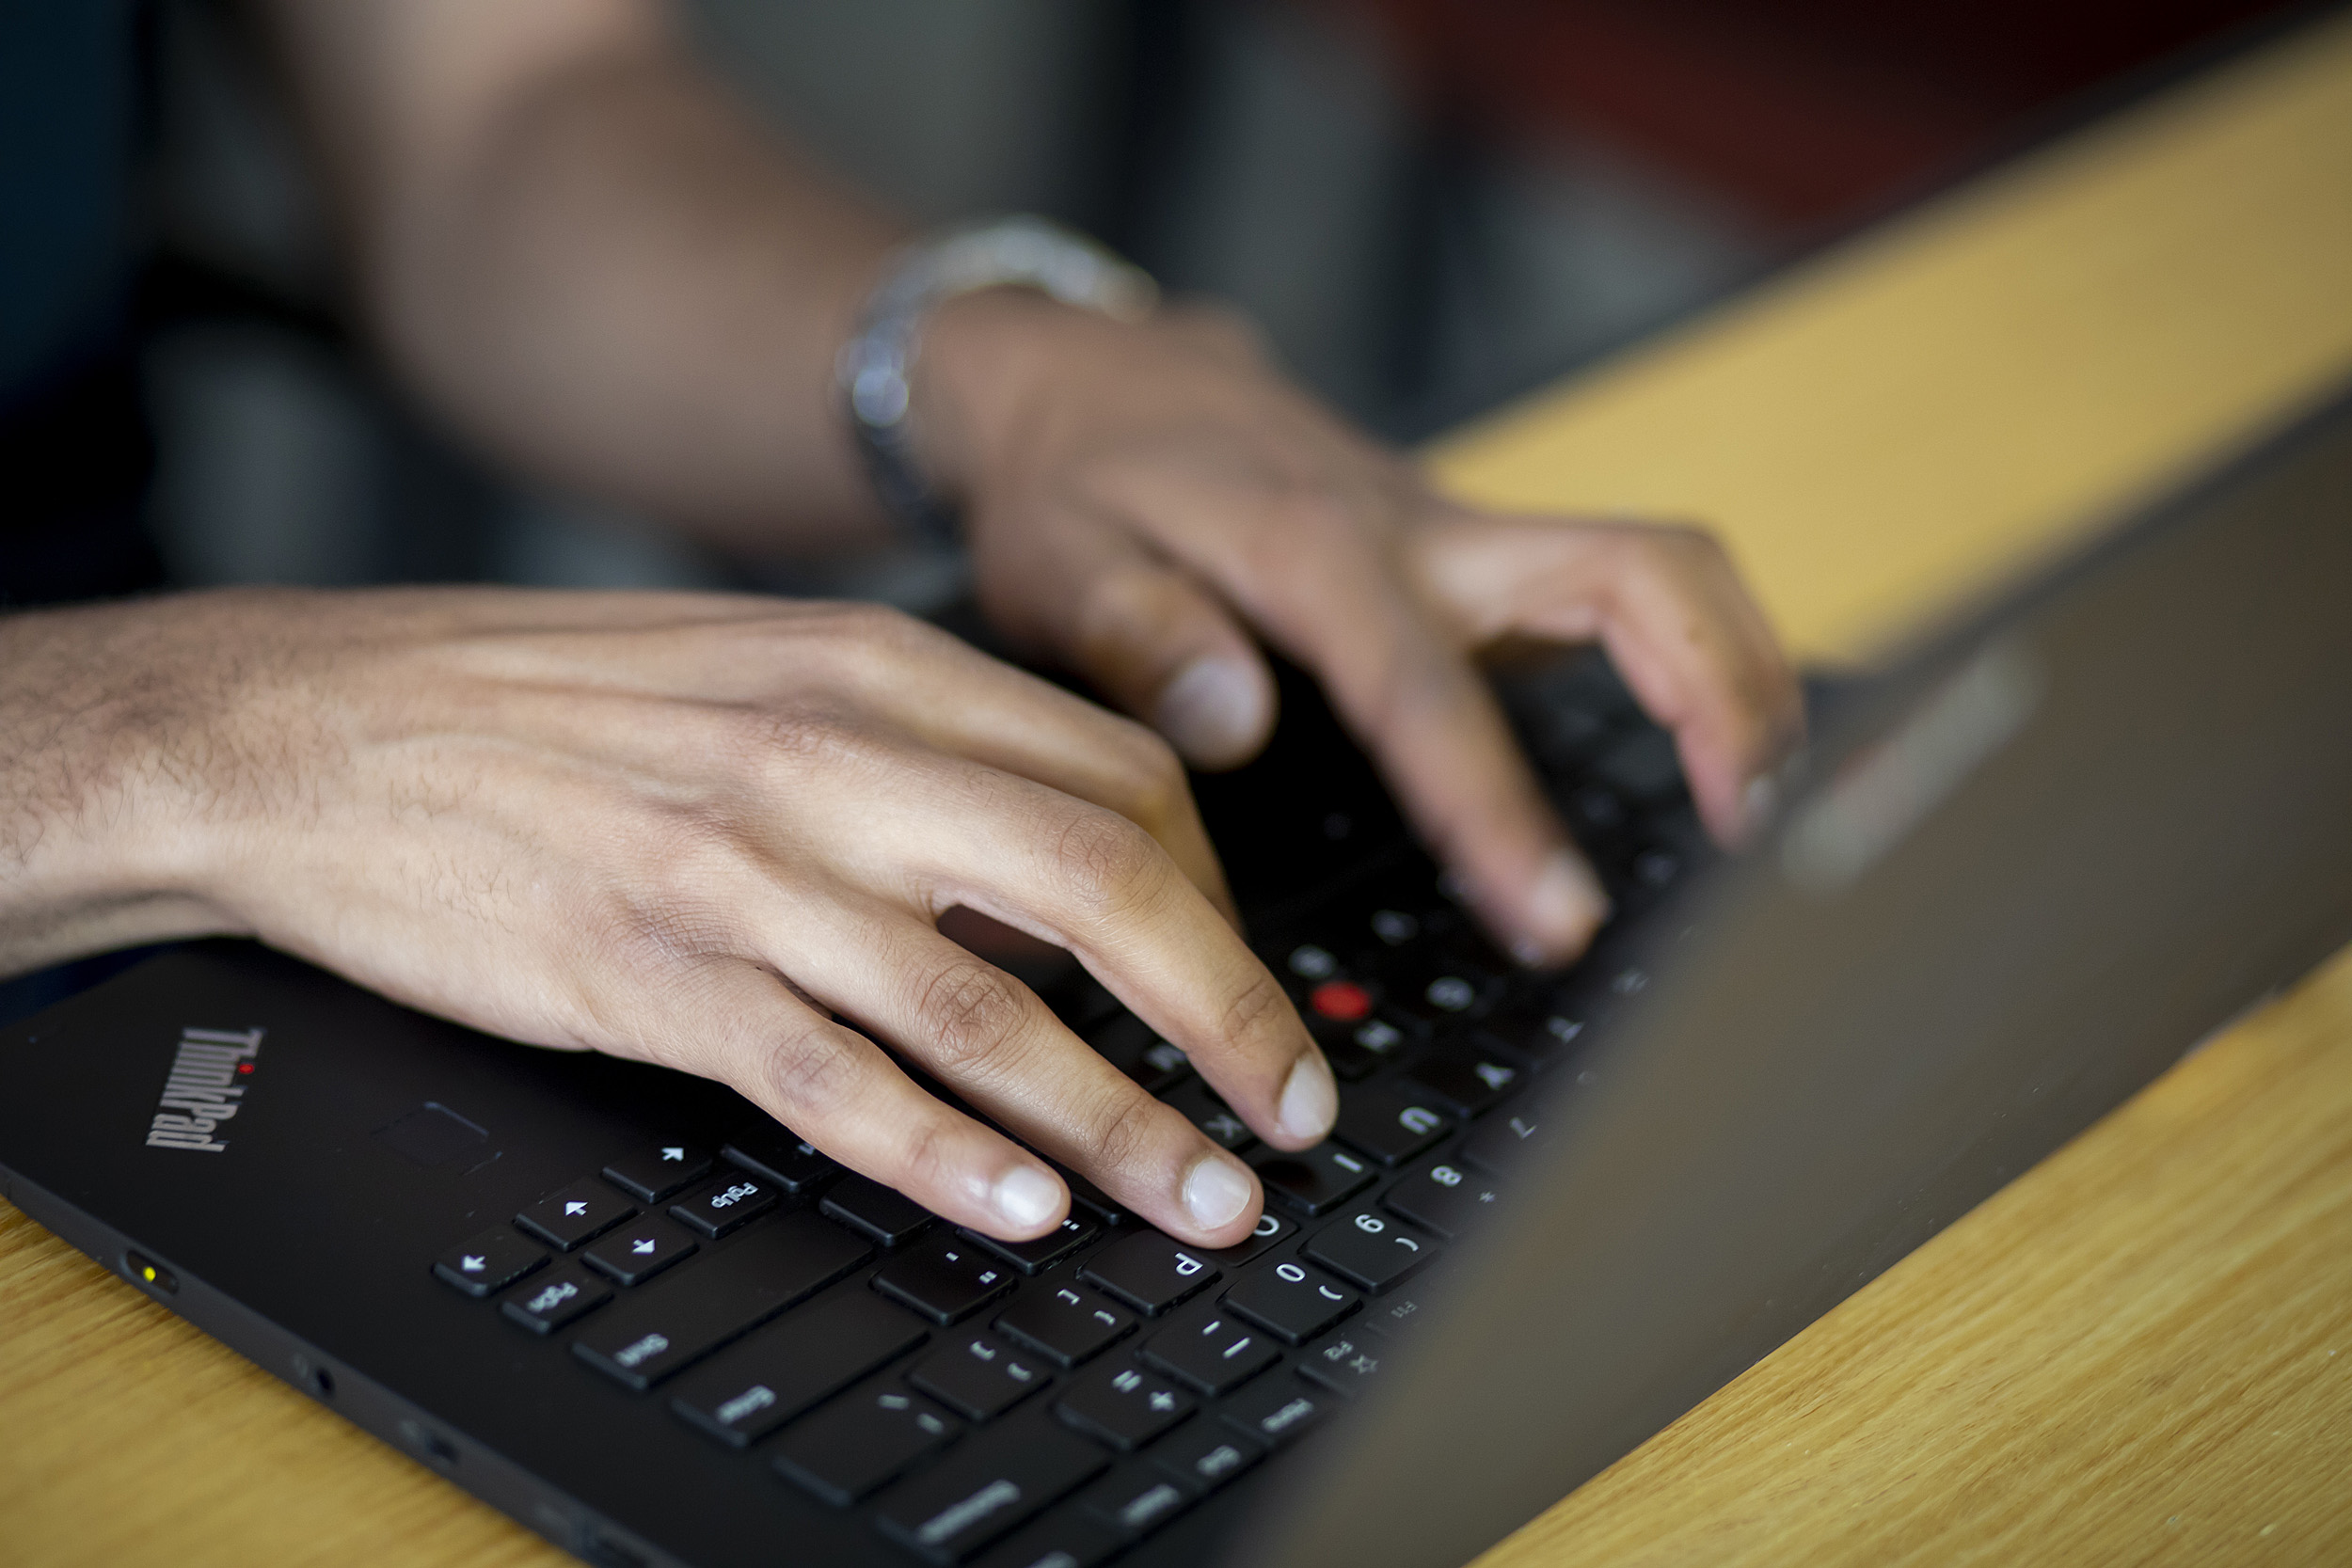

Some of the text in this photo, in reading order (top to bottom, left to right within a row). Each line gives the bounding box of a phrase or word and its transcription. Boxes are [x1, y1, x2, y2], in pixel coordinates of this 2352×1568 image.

[145, 1028, 264, 1153] ThinkPad
[1399, 1106, 1438, 1133] U
[1430, 1165, 1463, 1186] 8
[711, 1181, 759, 1209] PgUp
[1354, 1213, 1385, 1234] 9
[1175, 1252, 1204, 1276] P
